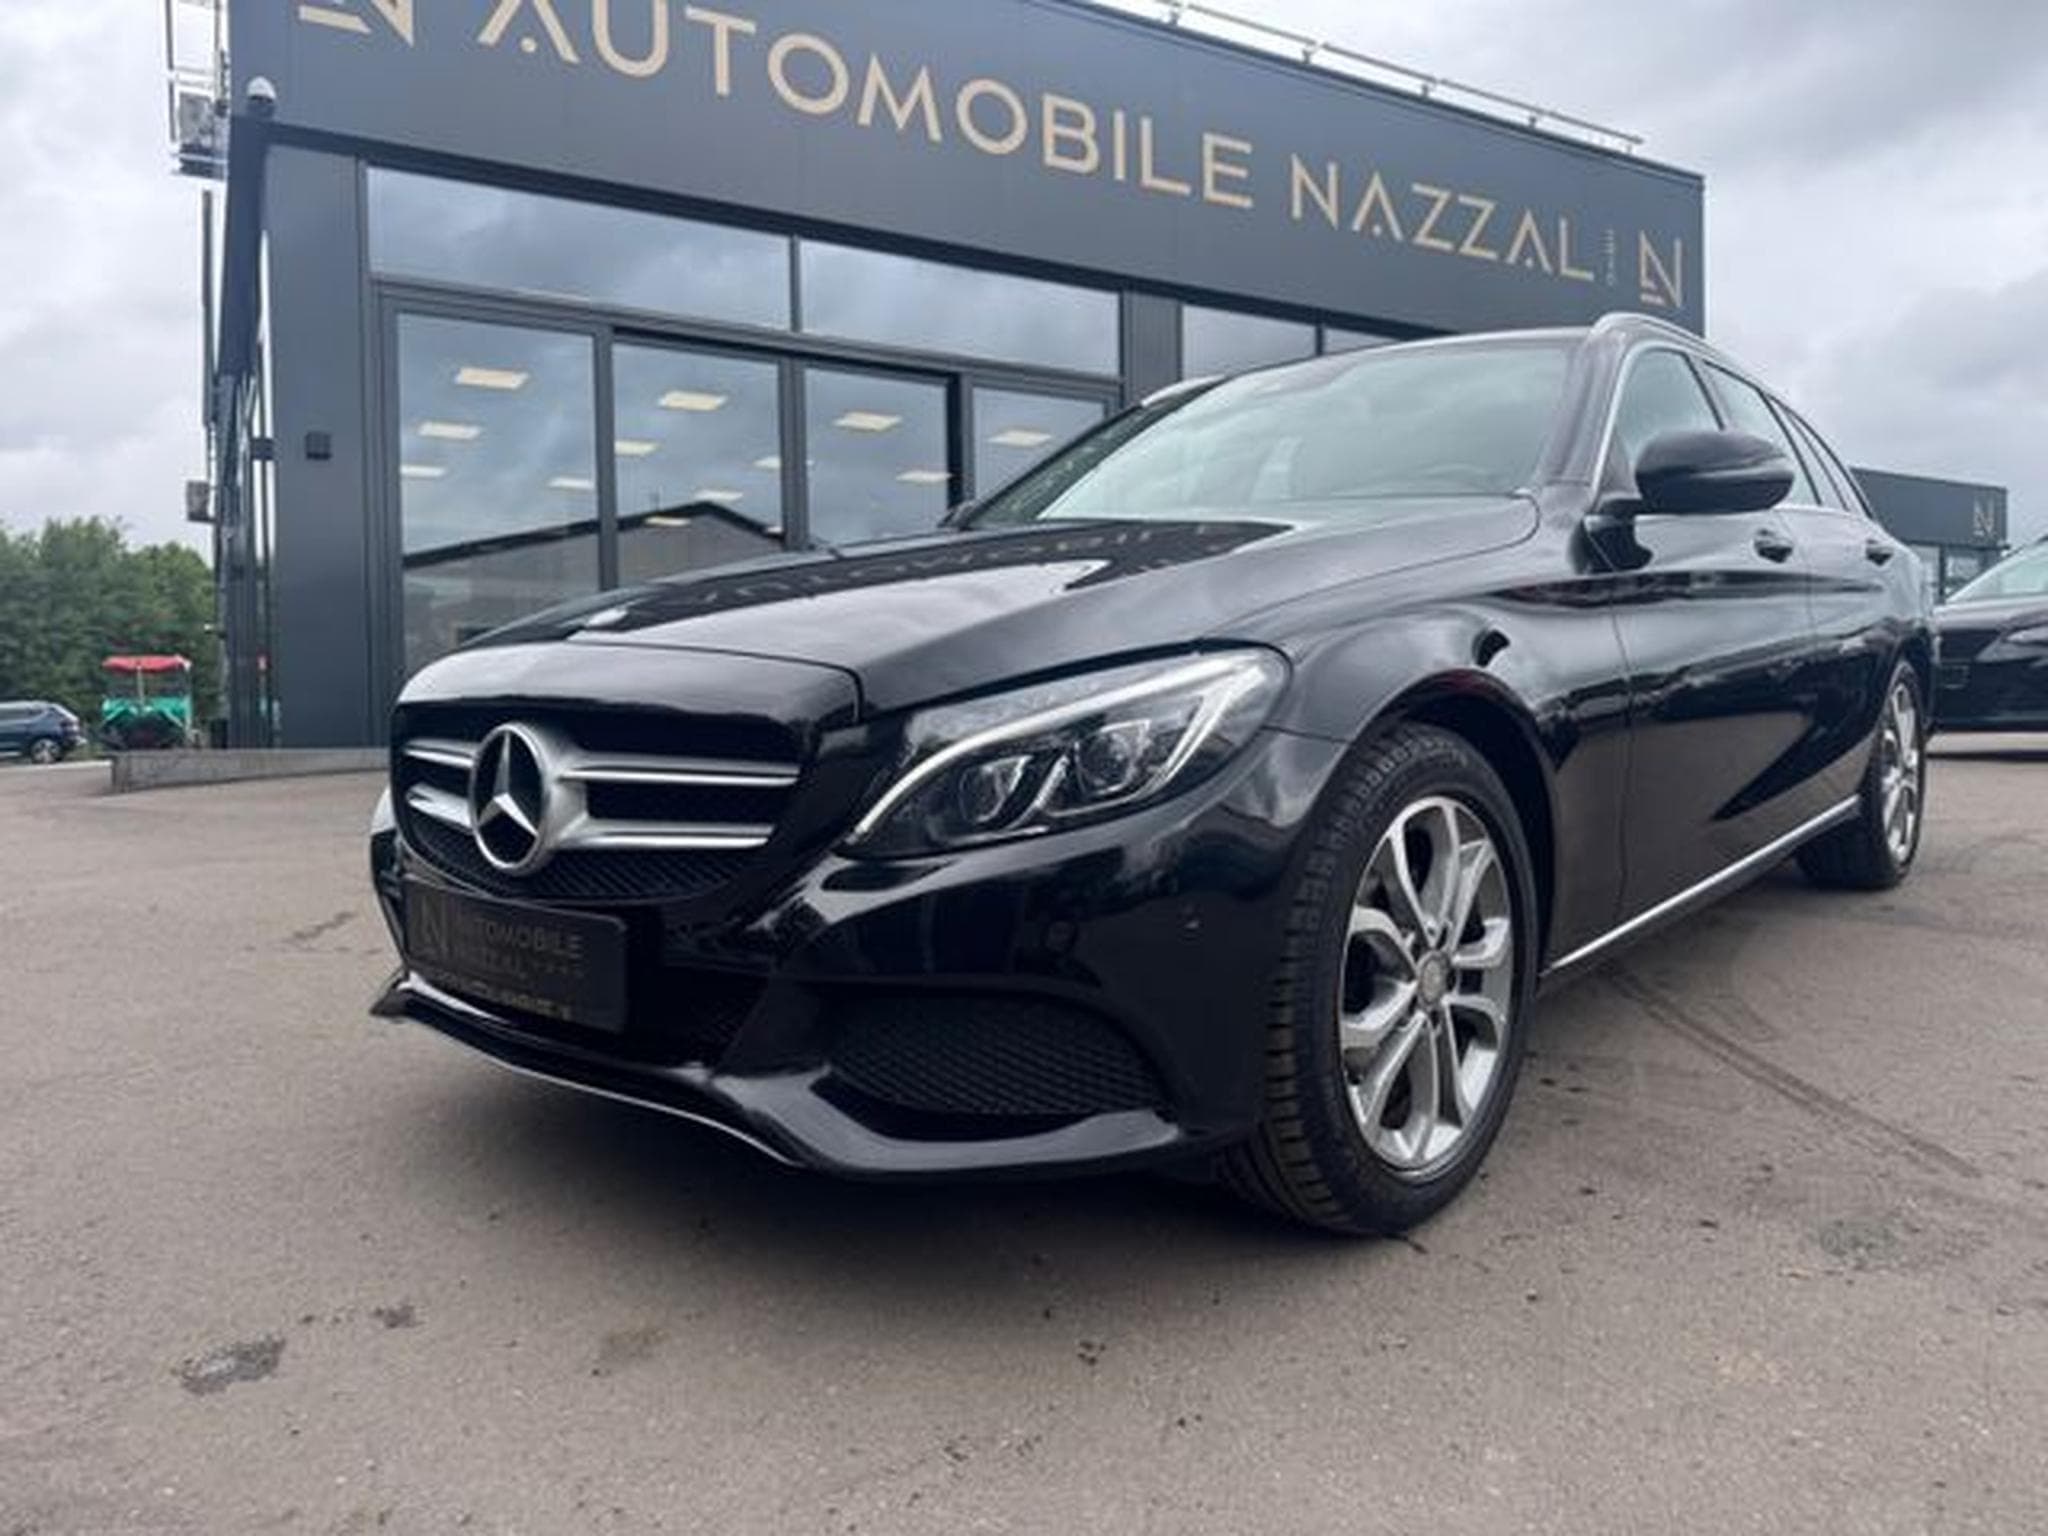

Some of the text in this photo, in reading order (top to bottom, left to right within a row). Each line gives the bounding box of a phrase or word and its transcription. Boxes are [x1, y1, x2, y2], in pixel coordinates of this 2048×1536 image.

[477, 0, 1595, 282] AUTOMOBILE NAZZAL
[1638, 229, 1683, 308] N
[450, 911, 584, 960] TOMOBILE
